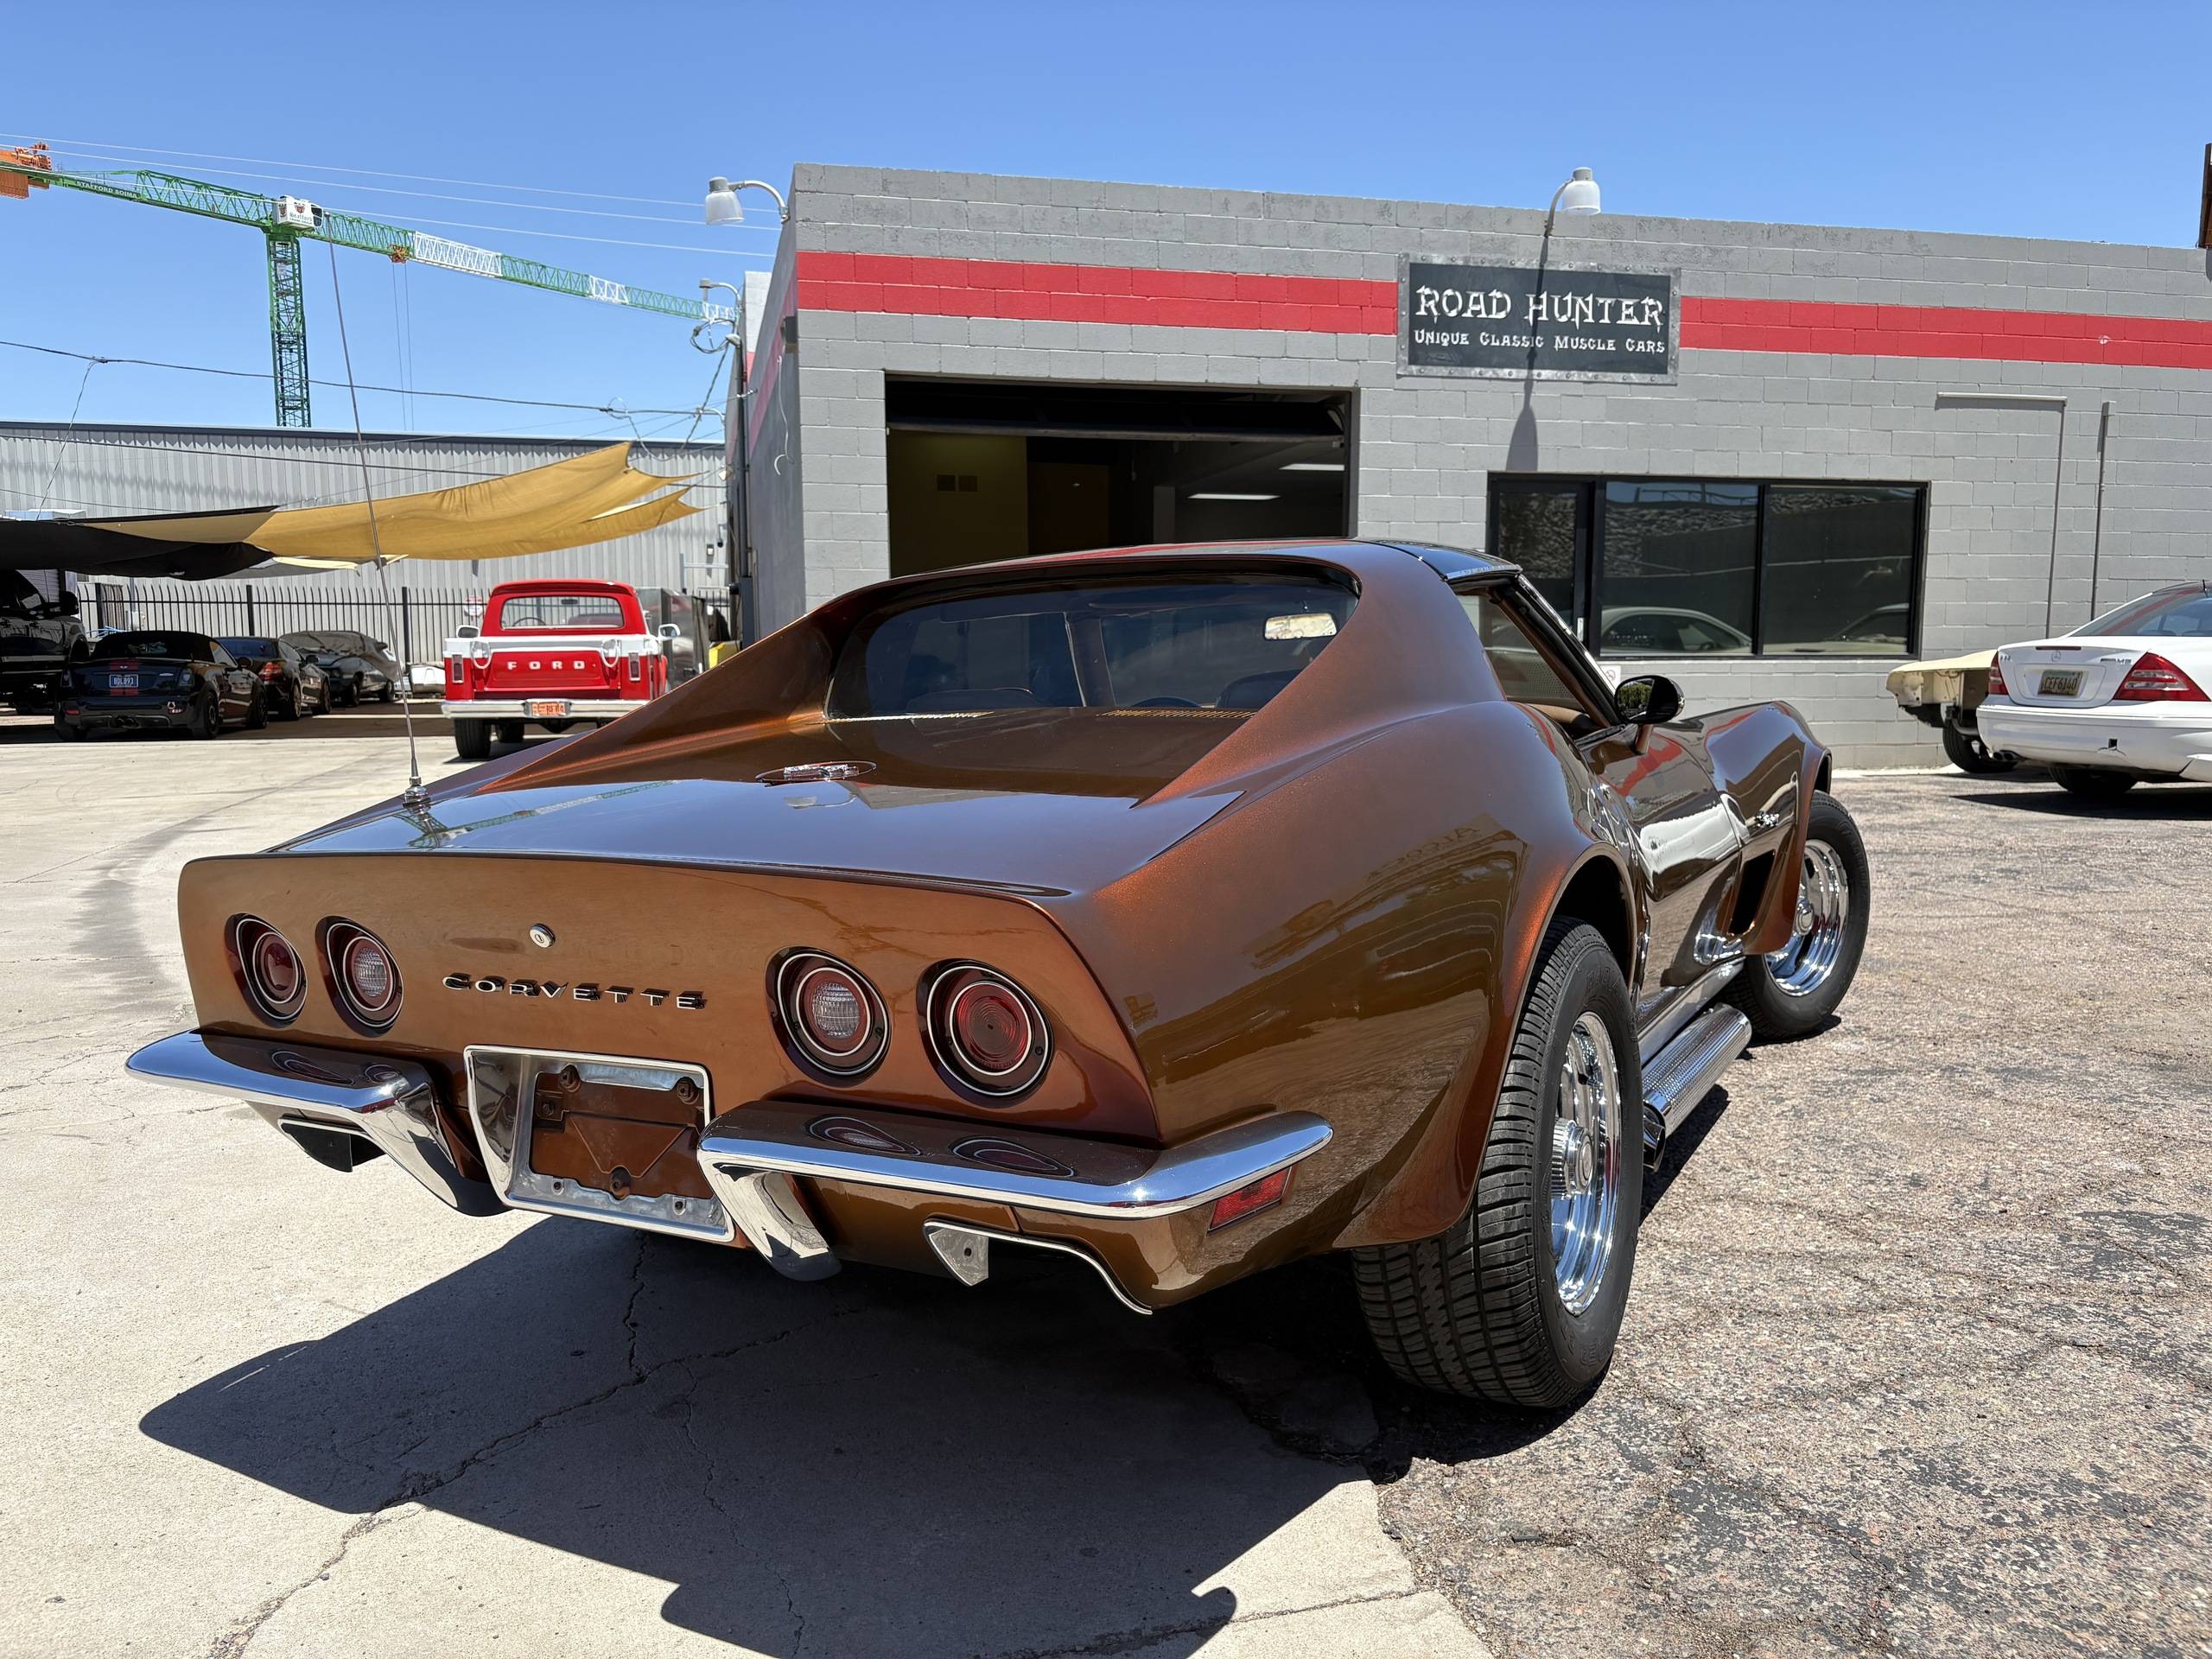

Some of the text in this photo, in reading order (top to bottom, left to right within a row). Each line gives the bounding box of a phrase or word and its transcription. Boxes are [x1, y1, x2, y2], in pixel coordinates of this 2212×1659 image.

[1415, 284, 1663, 333] ROAD HUNTER
[507, 660, 586, 670] FORD
[442, 972, 707, 1010] CORVETTE
